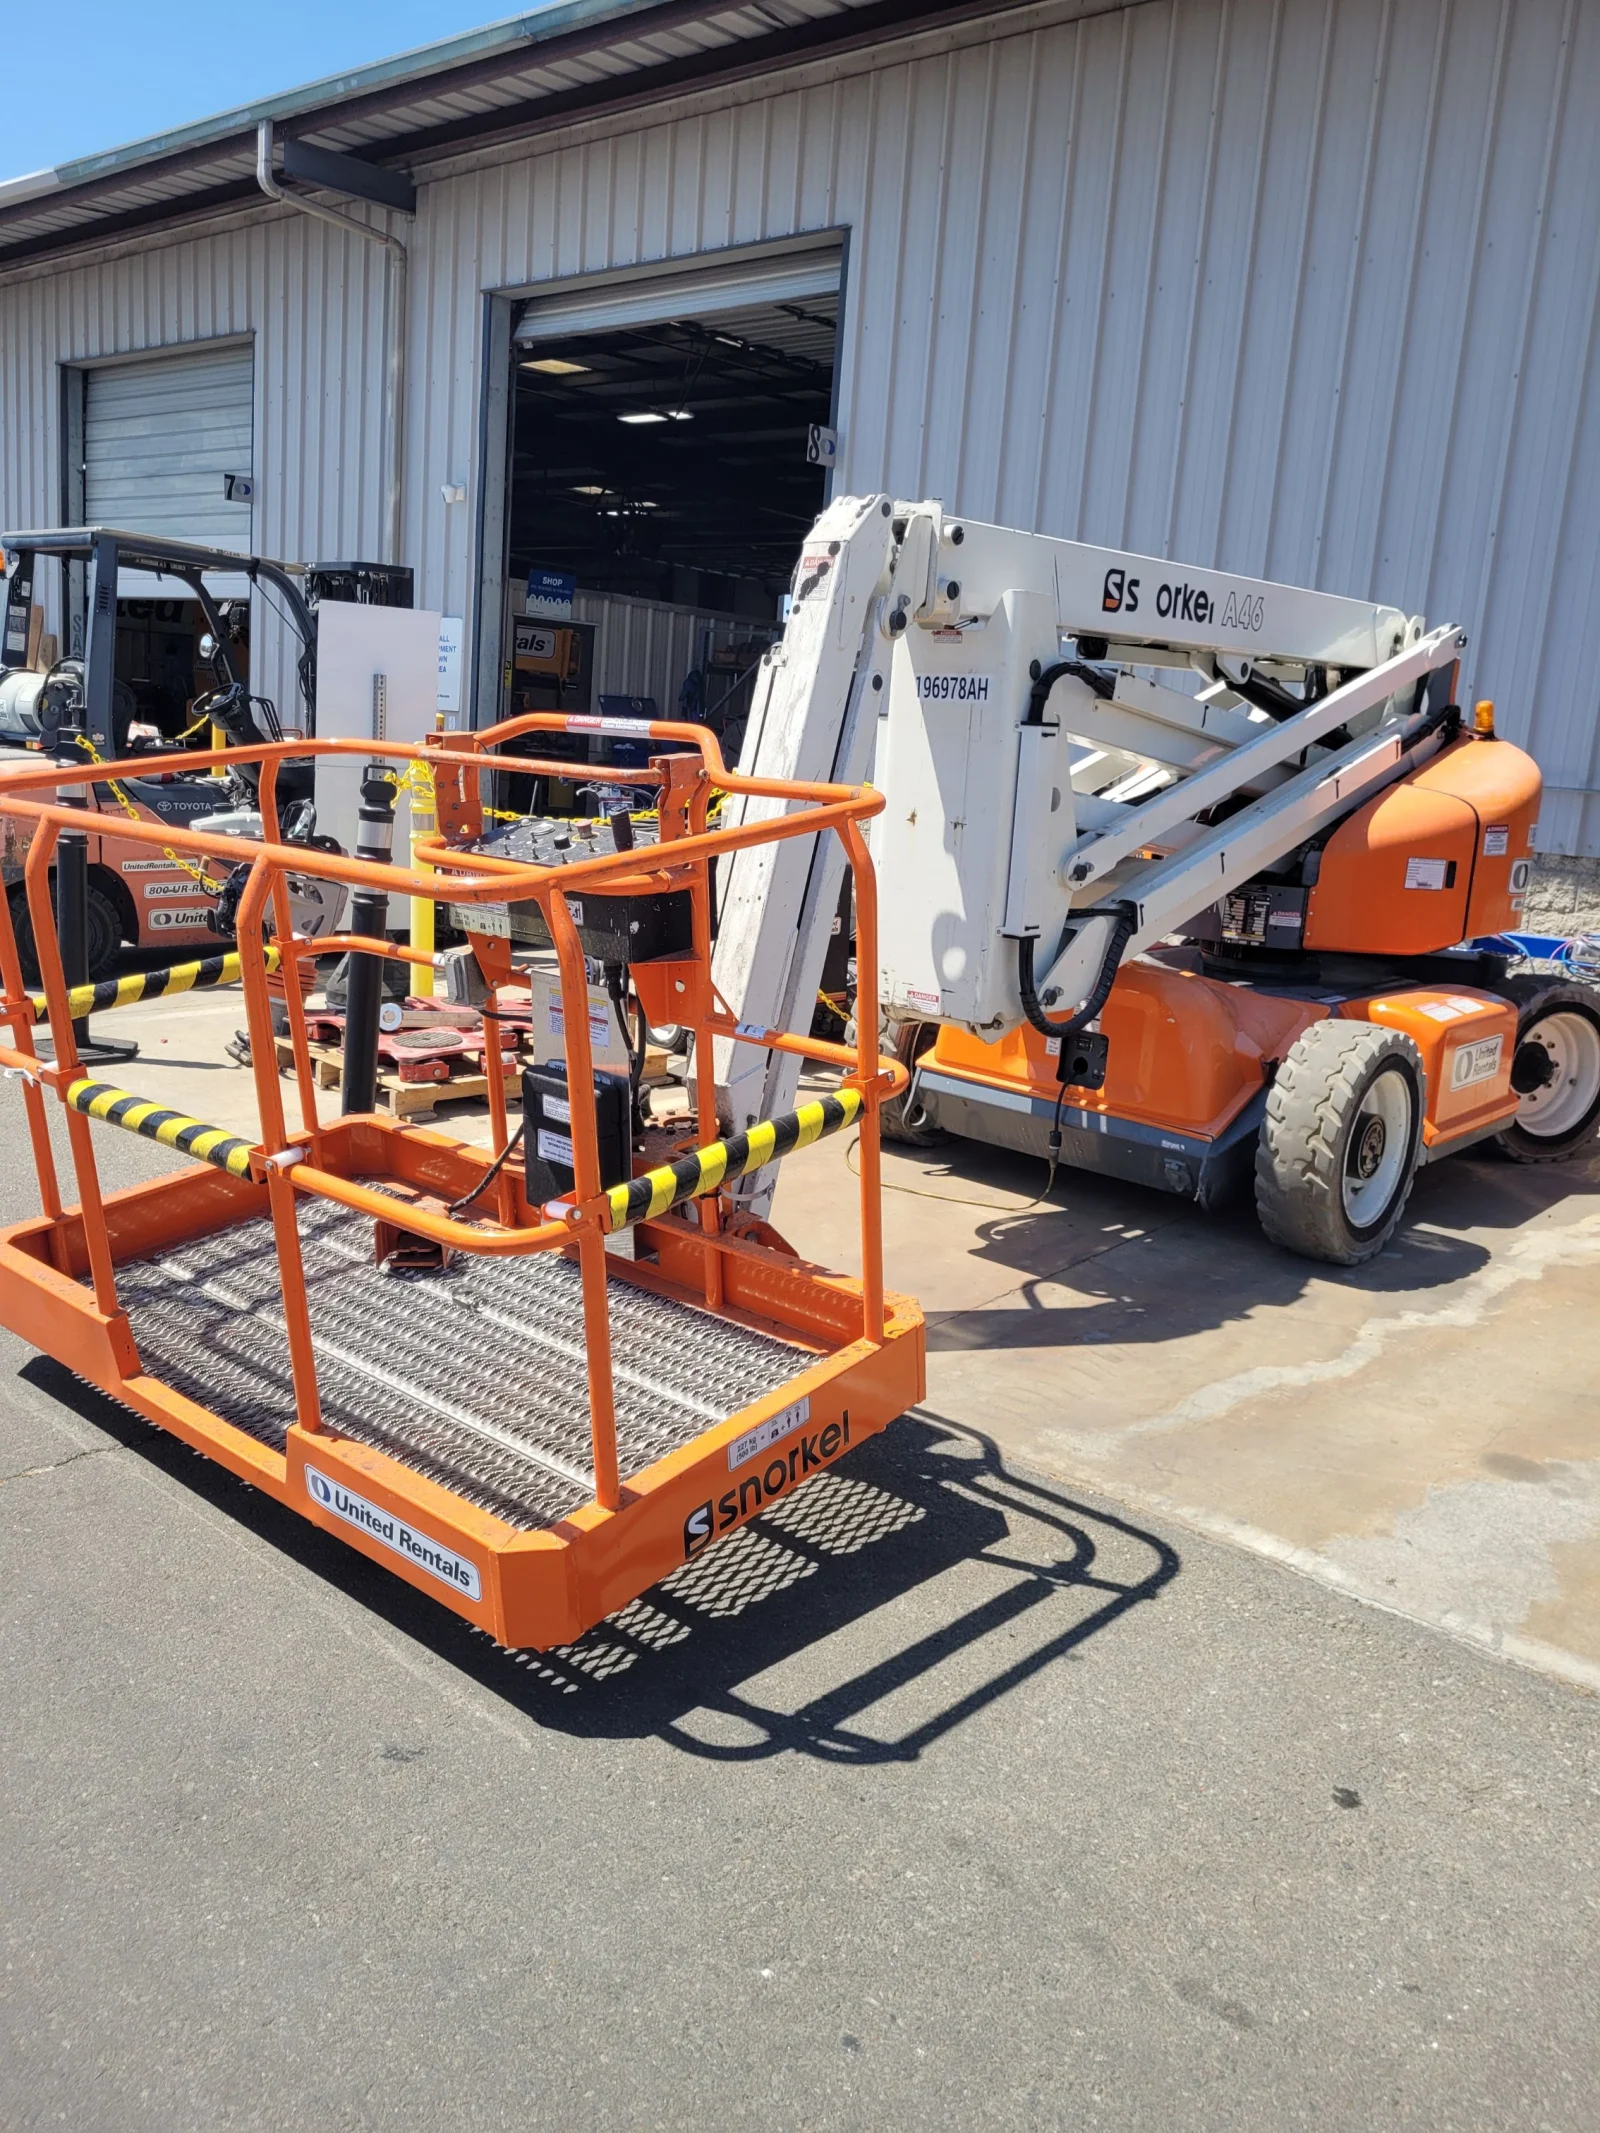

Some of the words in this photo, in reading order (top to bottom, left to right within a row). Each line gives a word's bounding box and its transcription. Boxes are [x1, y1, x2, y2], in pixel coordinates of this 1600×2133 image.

[224, 474, 236, 500] 7
[542, 576, 563, 586] SHOP
[1221, 592, 1264, 632] A46
[438, 645, 457, 653] MENT
[517, 635, 546, 652] als
[916, 676, 989, 700] 196978AH
[173, 802, 212, 811] TOYOTA
[175, 912, 209, 924] Unite
[915, 993, 937, 1002] DANGER
[1475, 1042, 1498, 1062] United
[1473, 1058, 1497, 1078] Rentals
[737, 1440, 748, 1452] 227
[749, 1436, 756, 1444] kg
[736, 1449, 748, 1462] (500
[718, 1409, 850, 1532] snorkel
[335, 1489, 394, 1541] United
[399, 1528, 471, 1587] Rentals
